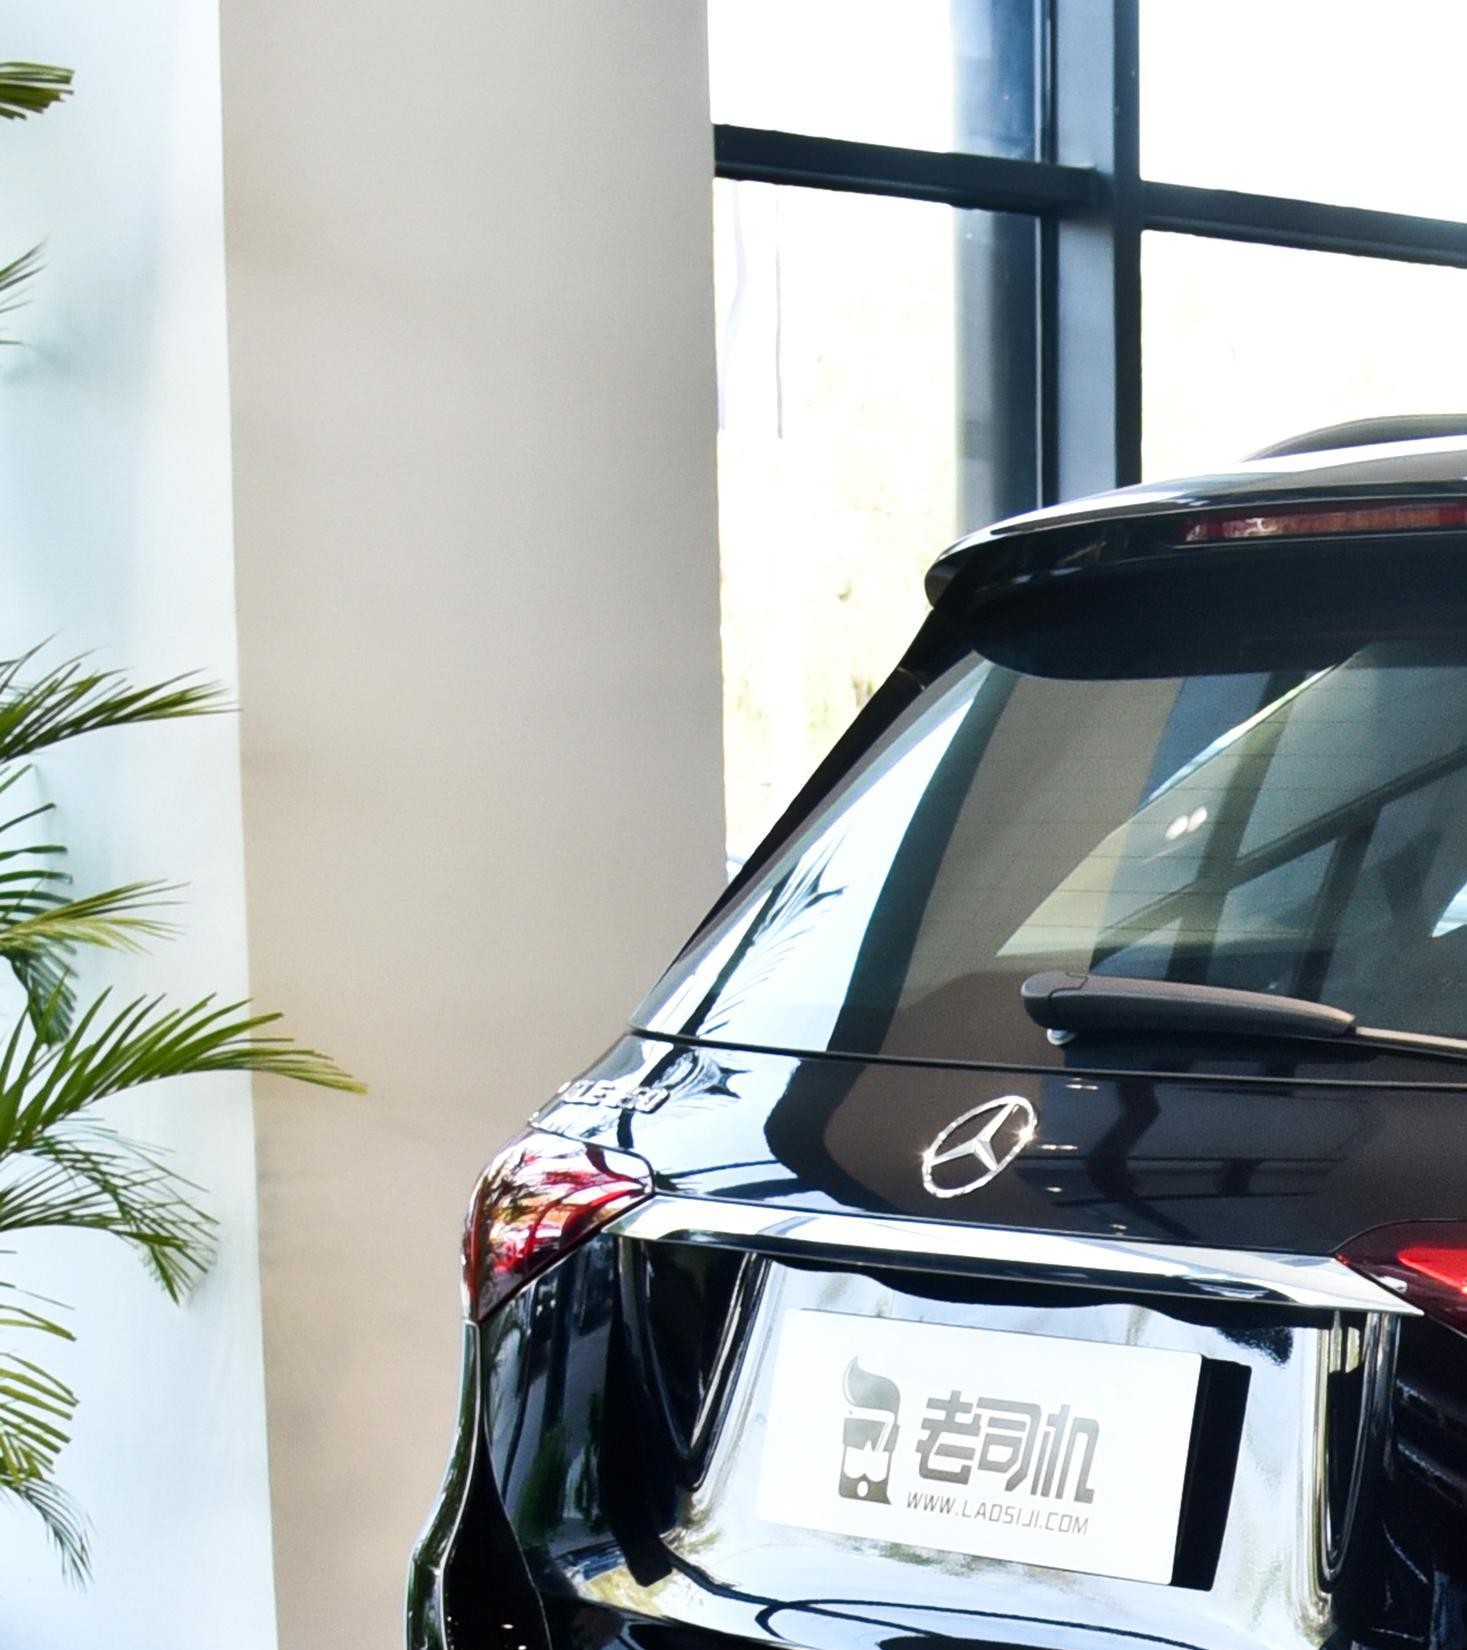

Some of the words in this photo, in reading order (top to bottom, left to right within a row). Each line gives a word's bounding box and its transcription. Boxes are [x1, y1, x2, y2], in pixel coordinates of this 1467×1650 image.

[915, 1389, 1100, 1504] 老司机
[906, 1491, 1089, 1535] WWW.LAOSIJI.COM
